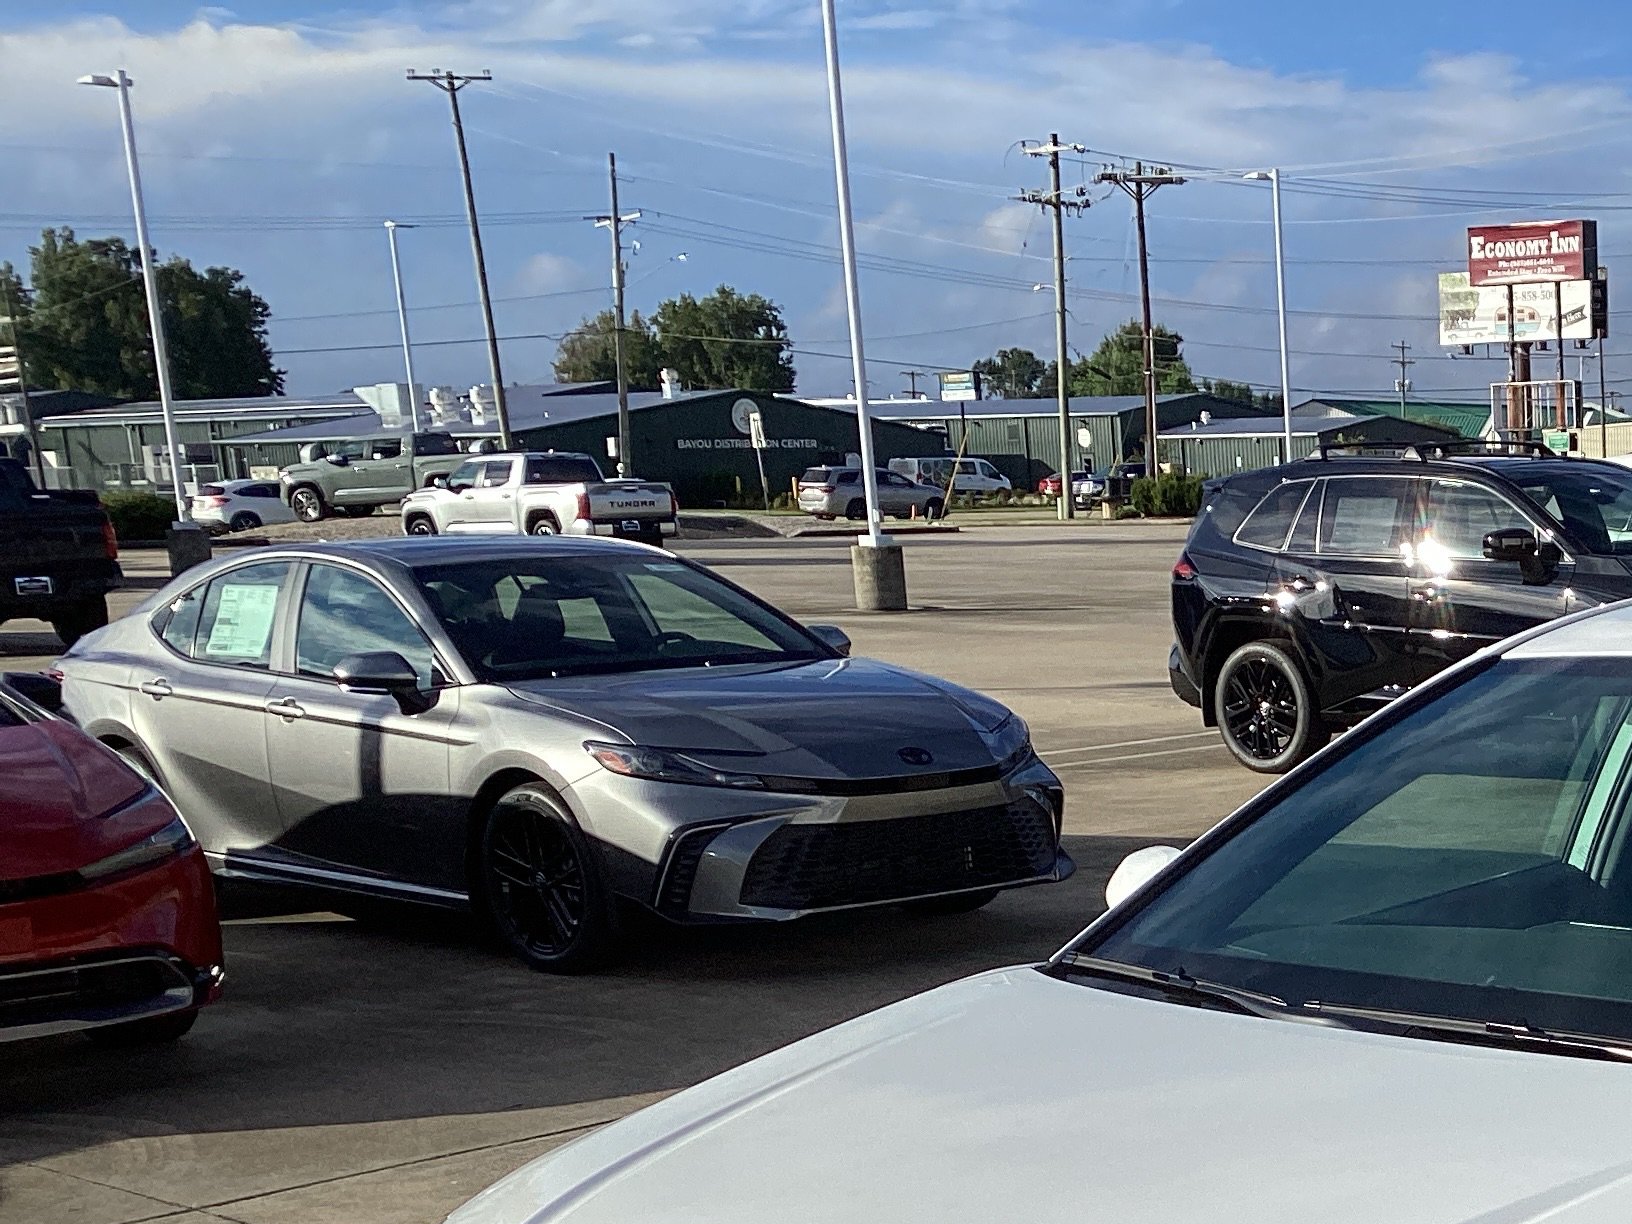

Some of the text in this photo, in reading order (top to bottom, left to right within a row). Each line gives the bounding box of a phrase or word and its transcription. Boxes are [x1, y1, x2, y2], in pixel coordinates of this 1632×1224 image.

[677, 438, 818, 449] BAYOU DISTRIBON CENTER
[609, 500, 656, 509] TUNDRA
